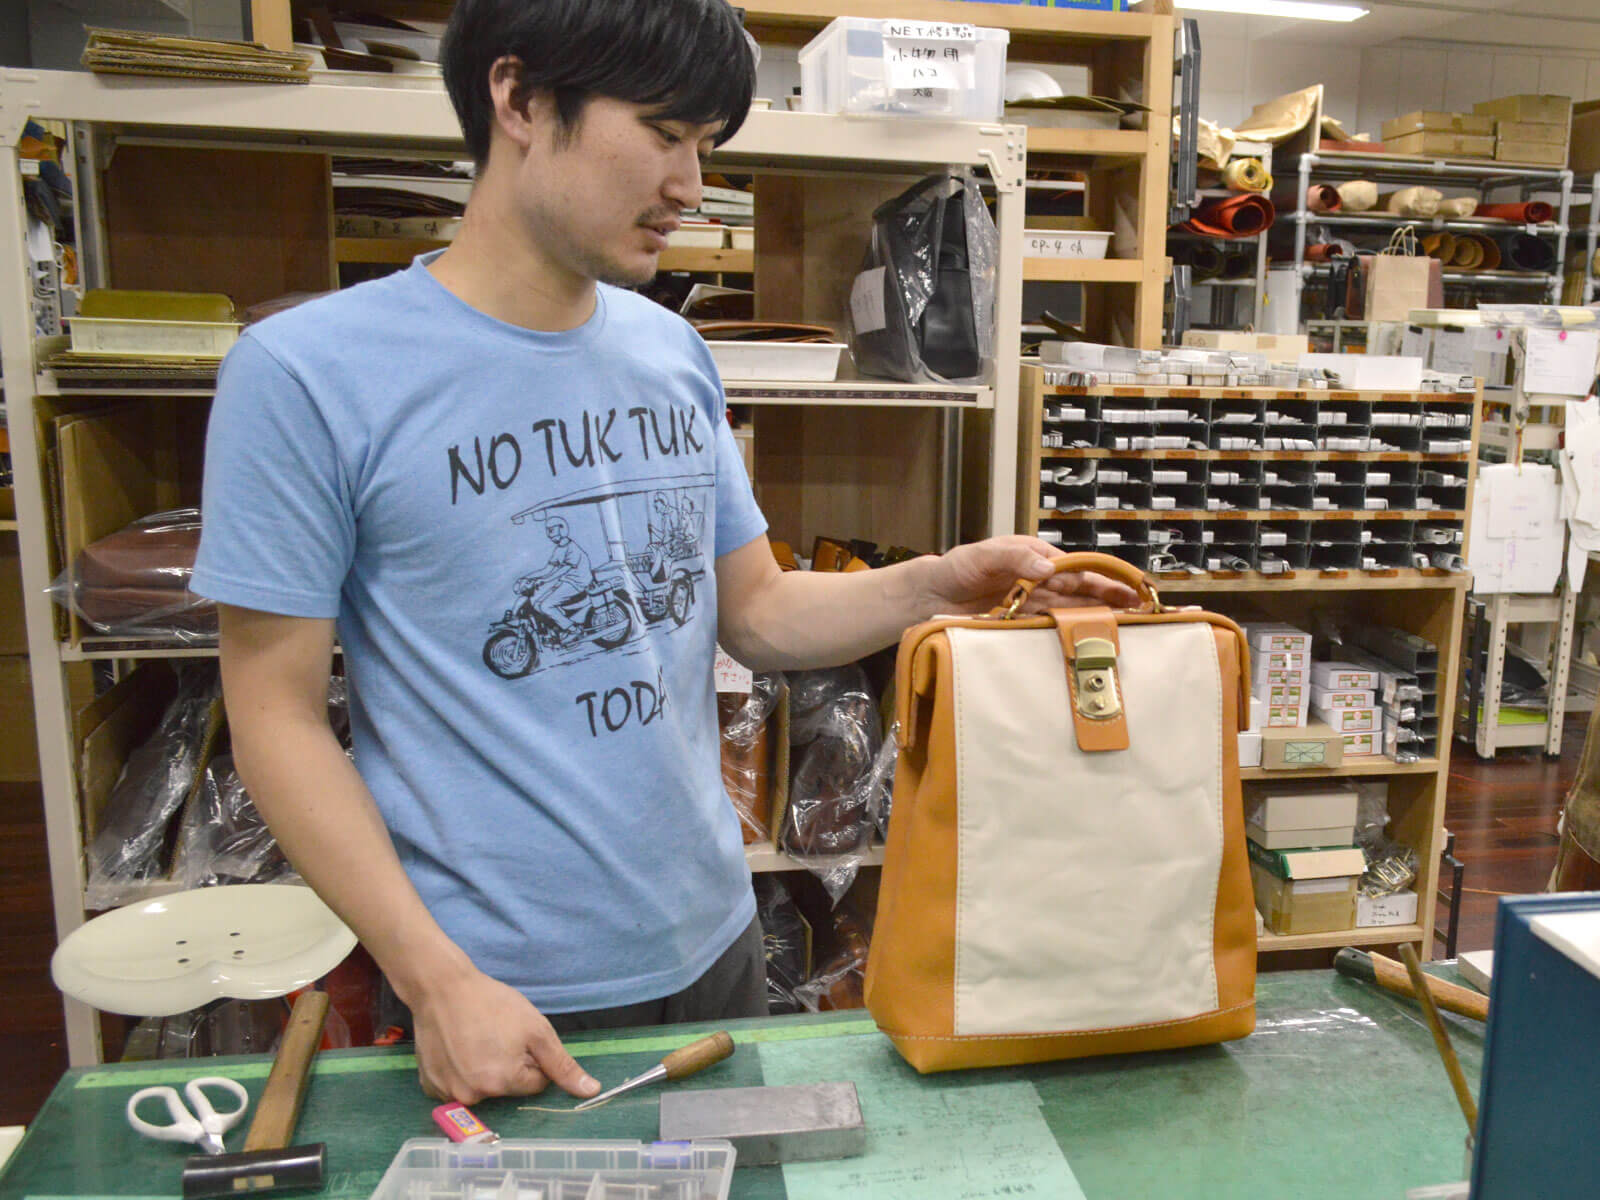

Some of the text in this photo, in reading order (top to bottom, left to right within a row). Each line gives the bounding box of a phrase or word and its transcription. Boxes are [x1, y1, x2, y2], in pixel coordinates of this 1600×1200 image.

[447, 404, 704, 505] NO TUK TUK
